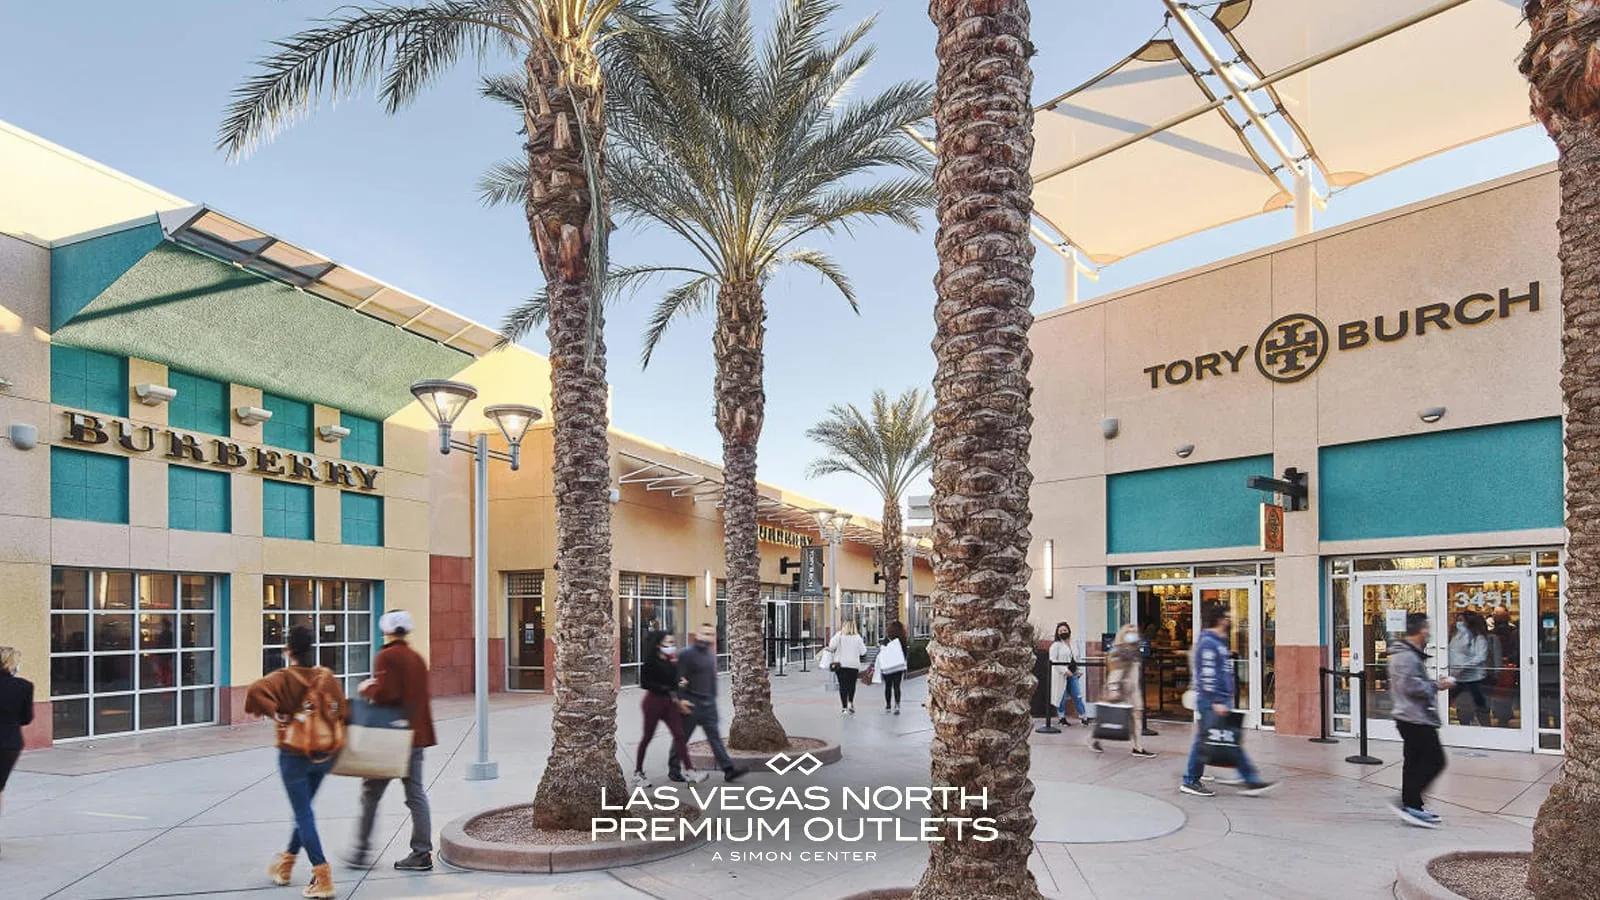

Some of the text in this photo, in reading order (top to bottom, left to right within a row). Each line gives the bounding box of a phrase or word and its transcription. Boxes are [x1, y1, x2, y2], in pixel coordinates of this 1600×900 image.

[1143, 281, 1540, 389] TORY BURCH
[62, 410, 379, 491] BURBERRY
[758, 525, 814, 547] URBERRY
[1454, 590, 1514, 609] 3451
